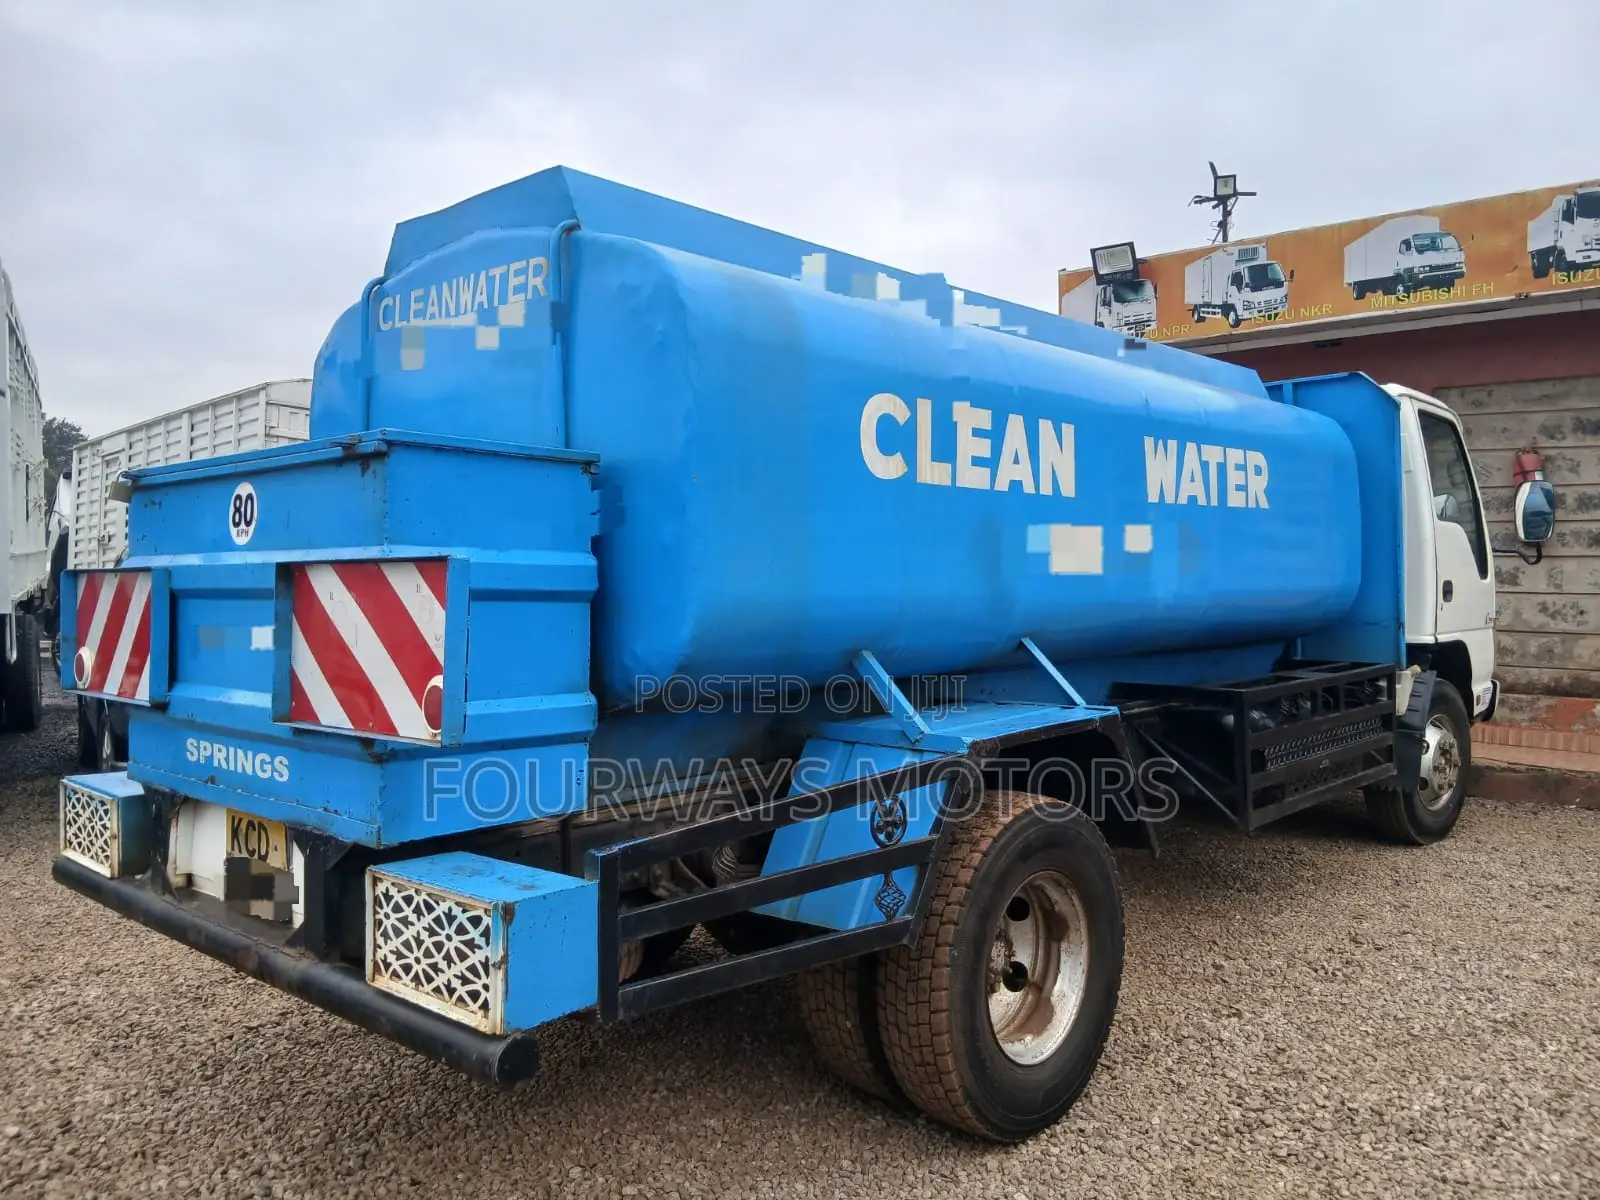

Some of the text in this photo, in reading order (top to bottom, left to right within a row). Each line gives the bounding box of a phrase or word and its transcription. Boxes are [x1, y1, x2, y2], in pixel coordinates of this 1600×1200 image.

[378, 256, 549, 331] CLEANWATER
[1251, 303, 1333, 325] ISUZU NKR
[1370, 285, 1466, 309] MITSUBISHI
[1162, 324, 1191, 337] NPR
[859, 392, 1270, 509] CLEAN WATER
[231, 492, 255, 529] 80
[186, 737, 290, 782] SPRINGS
[230, 814, 270, 863] KCD
